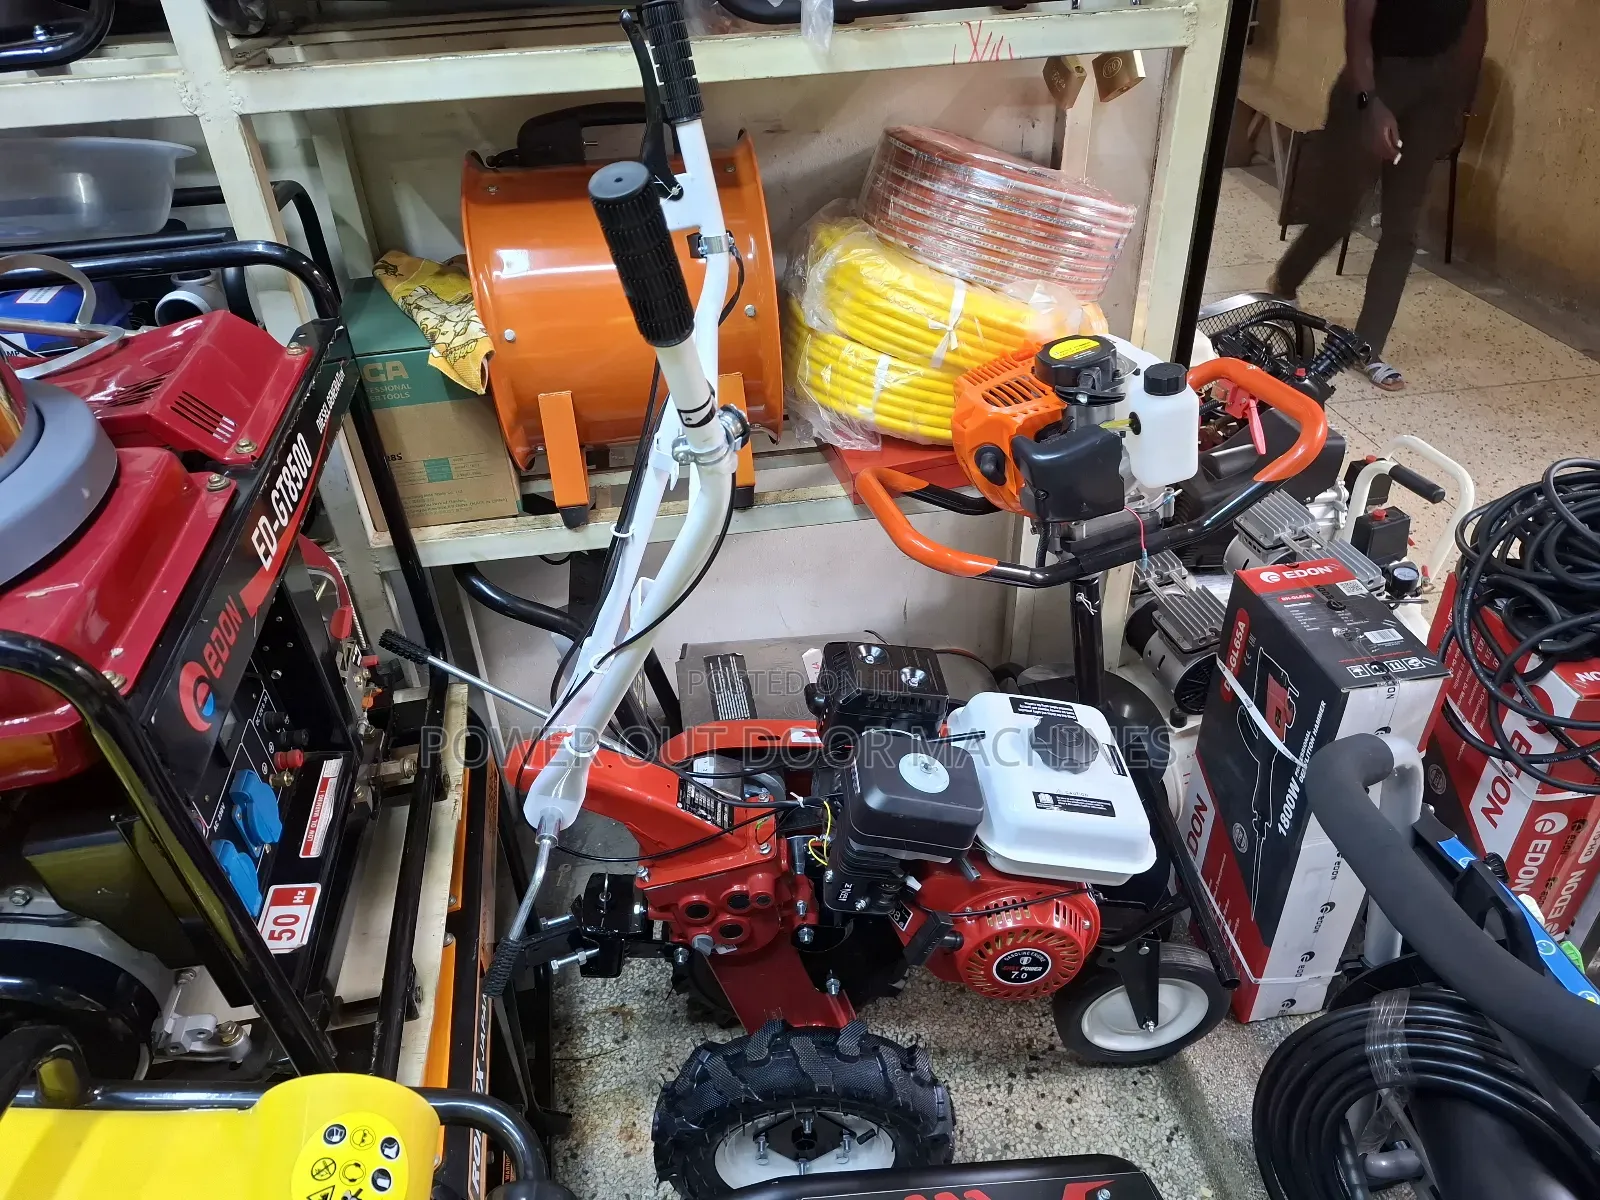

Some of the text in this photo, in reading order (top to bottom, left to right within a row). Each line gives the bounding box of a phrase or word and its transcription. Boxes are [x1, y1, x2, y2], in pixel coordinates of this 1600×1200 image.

[363, 360, 411, 383] CA
[366, 384, 413, 394] FESSIONAL
[381, 391, 411, 401] TOOLS
[251, 432, 313, 571] ED-GT8500
[1282, 565, 1333, 580] EDON
[1223, 621, 1246, 692] D-GL65A
[1277, 777, 1302, 838] 1800W
[1311, 700, 1327, 738] HAMMER
[314, 794, 325, 818] WARNING
[213, 822, 219, 833] AC
[310, 818, 318, 829] OIL
[1187, 793, 1208, 859] DON
[306, 829, 315, 842] LOW
[1511, 839, 1552, 893] EDON
[1548, 869, 1586, 919] EDON
[268, 889, 306, 942] 50 Hz
[1004, 951, 1047, 963] GASOLINE ENGINE
